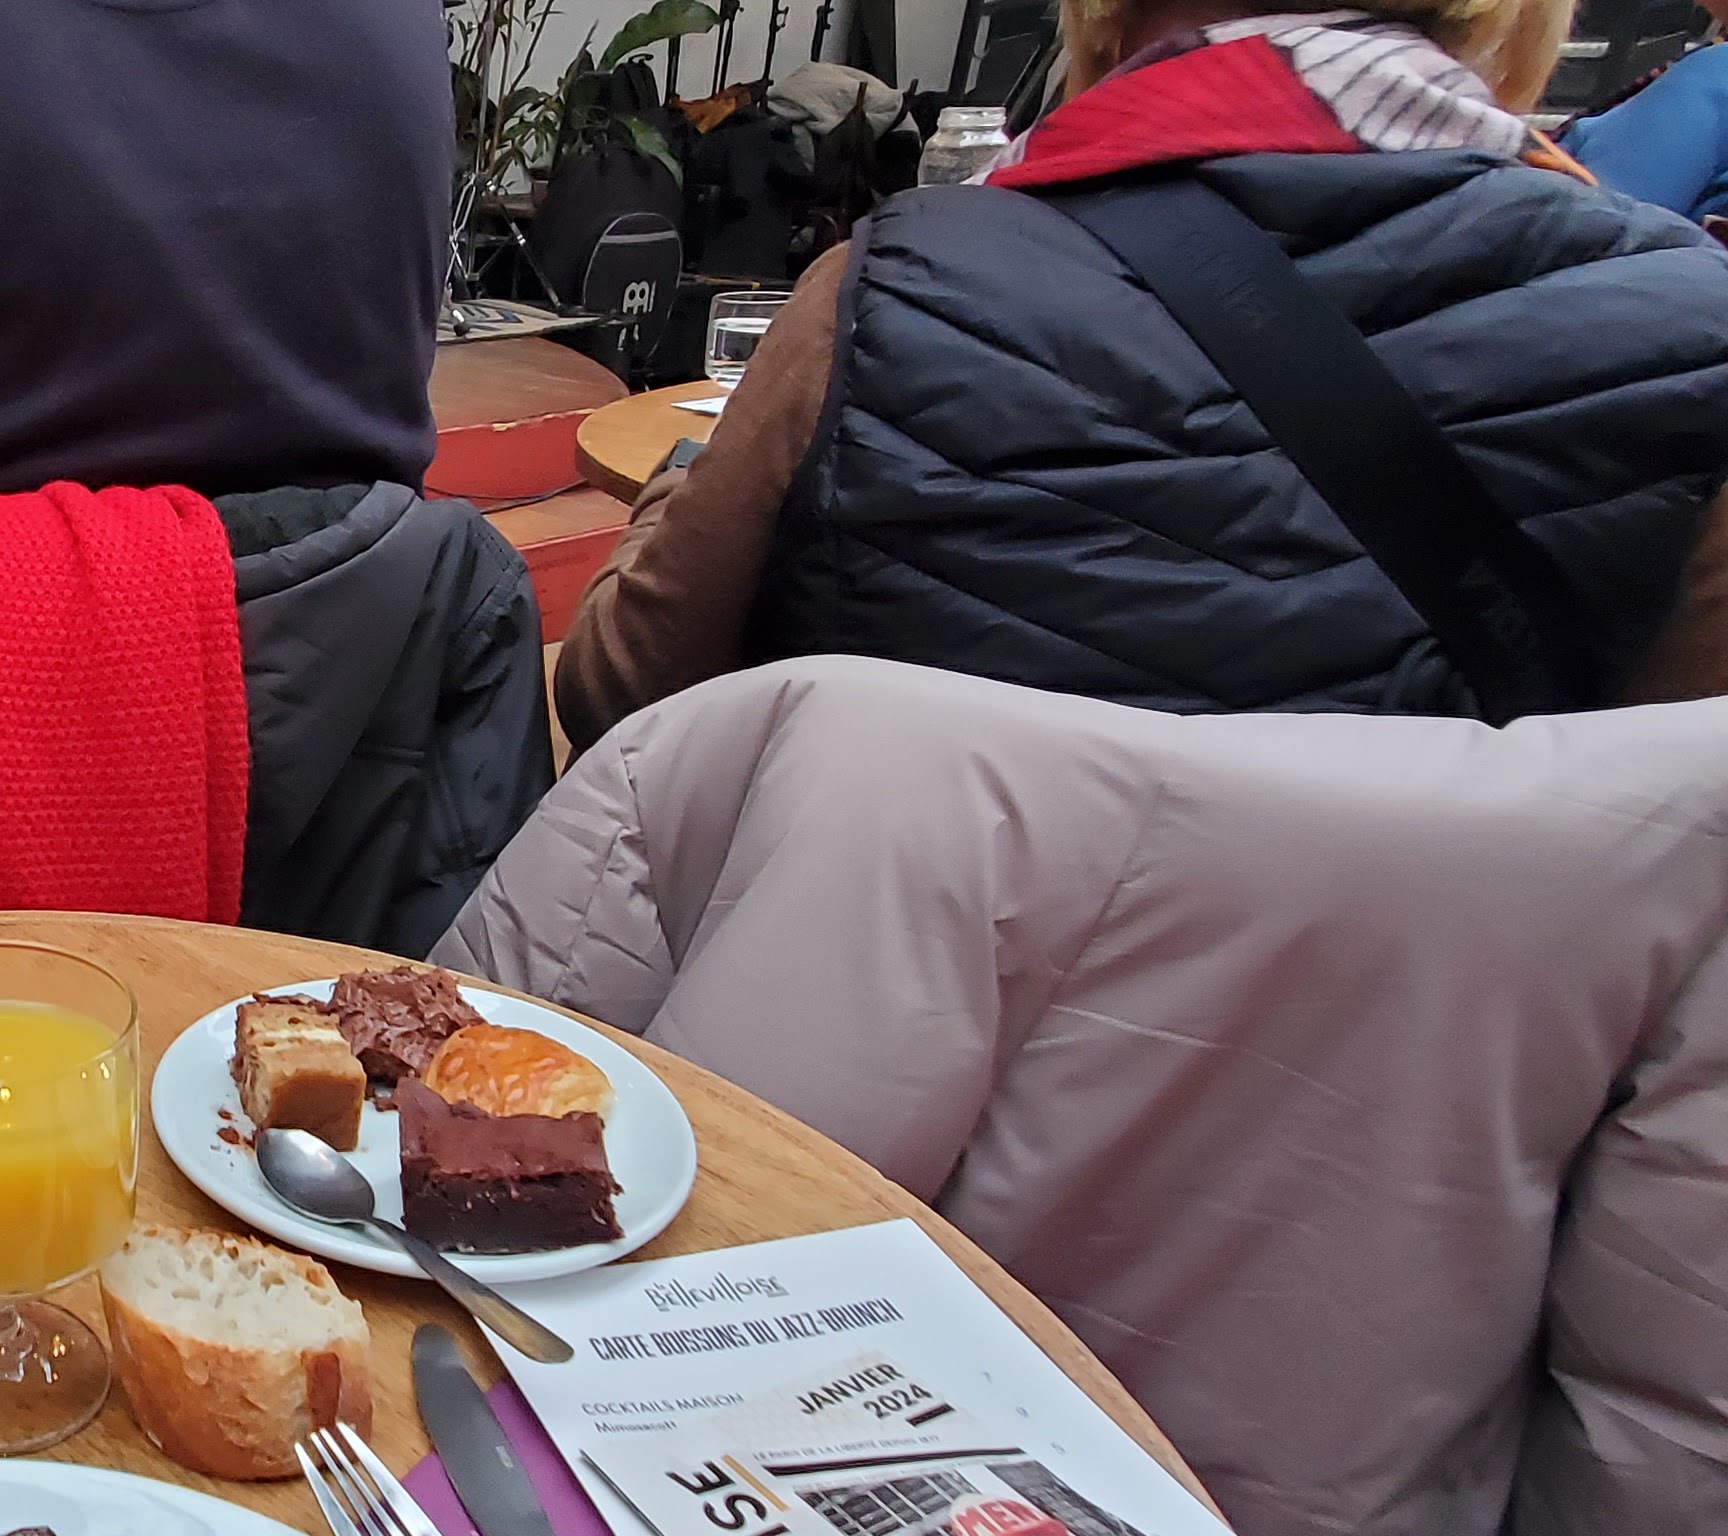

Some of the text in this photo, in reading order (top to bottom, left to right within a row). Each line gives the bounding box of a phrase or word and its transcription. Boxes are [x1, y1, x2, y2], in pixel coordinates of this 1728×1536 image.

[589, 1297, 904, 1361] CARTE BOISSONS DU JAZZ-BRUNCH
[581, 1392, 745, 1416] COCKTAILS MAISON
[795, 1363, 905, 1415] JANVIER
[863, 1383, 933, 1420] 2024
